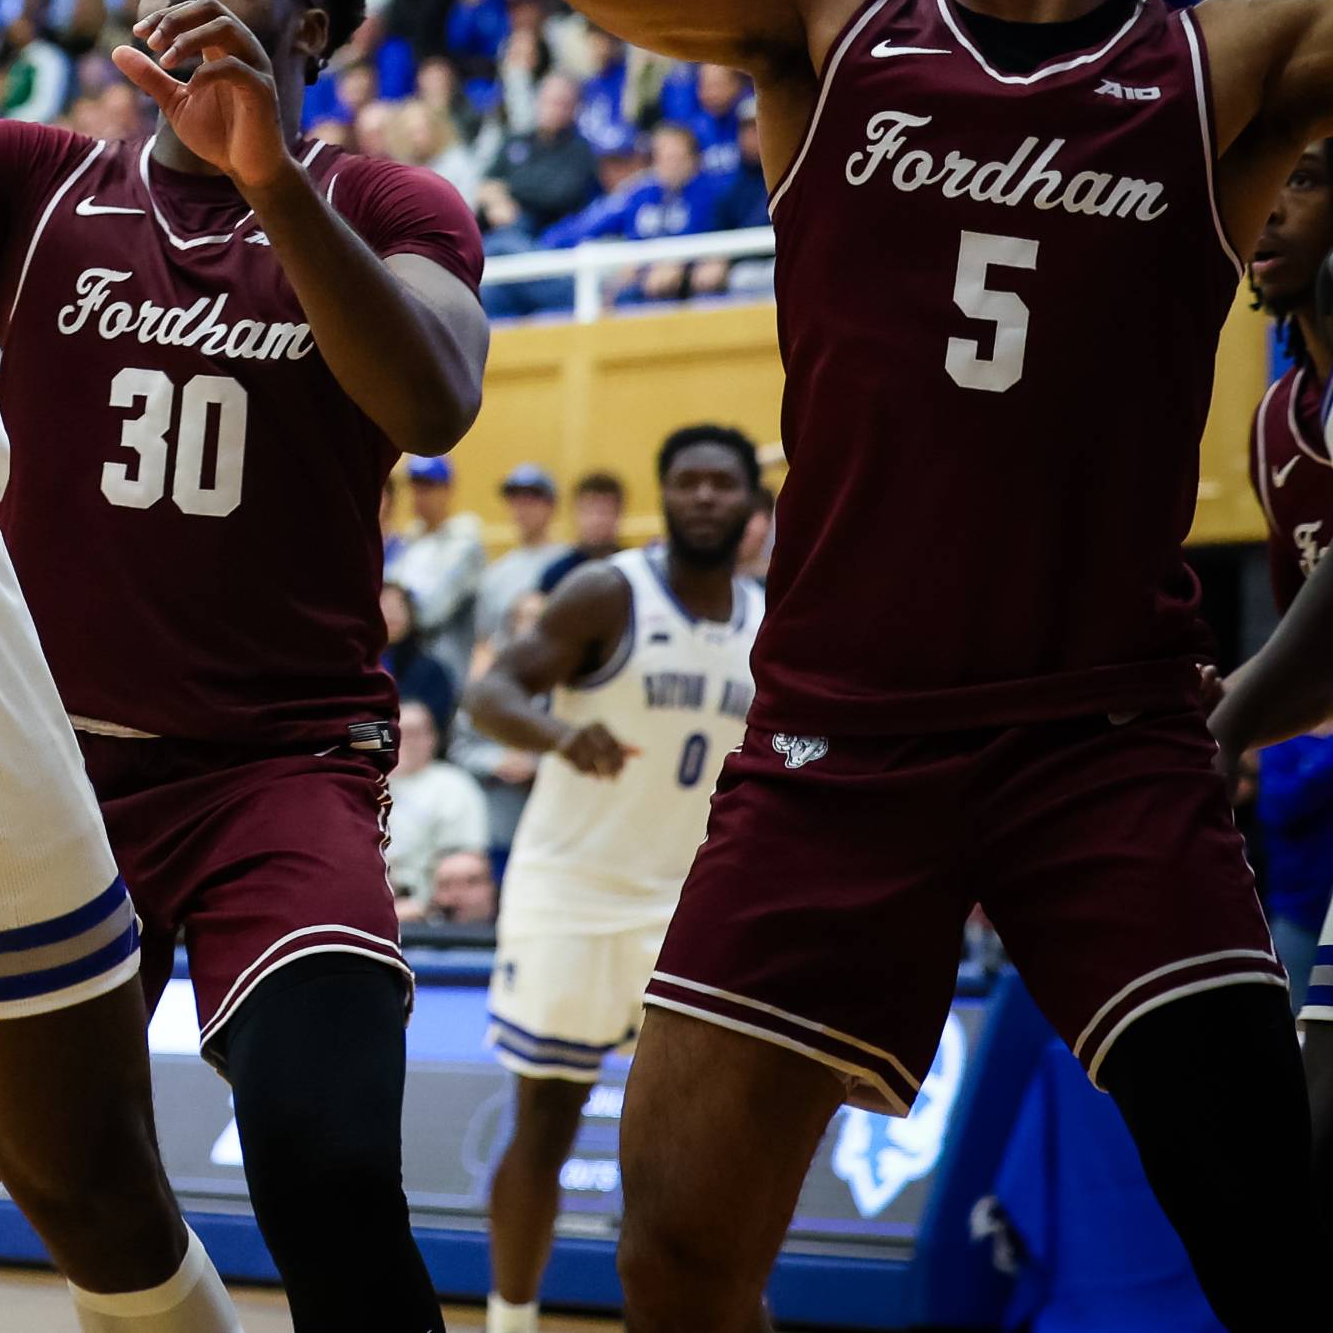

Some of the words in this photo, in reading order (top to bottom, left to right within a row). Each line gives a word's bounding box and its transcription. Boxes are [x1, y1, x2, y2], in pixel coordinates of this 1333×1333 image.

[1093, 79, 1161, 100] A10
[845, 110, 1169, 221] Fordham
[58, 267, 314, 361] Fordham
[945, 230, 1040, 393] 5
[100, 367, 248, 517] 30
[677, 732, 709, 791] 0
